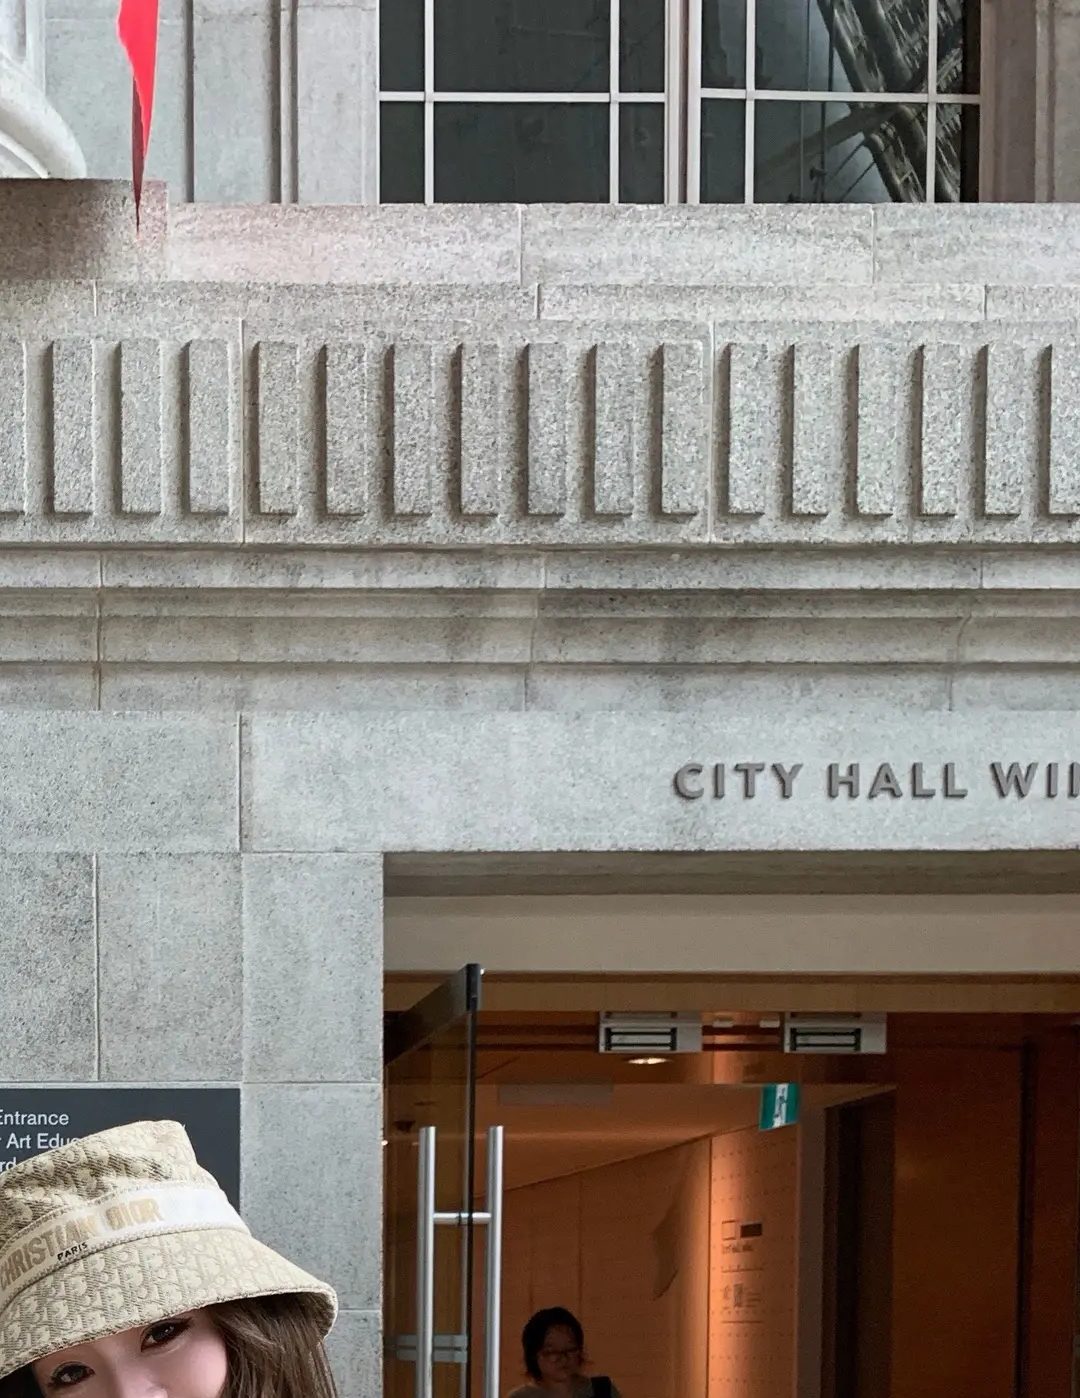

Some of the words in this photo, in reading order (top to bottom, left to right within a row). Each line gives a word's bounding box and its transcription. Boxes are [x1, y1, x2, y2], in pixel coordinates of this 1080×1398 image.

[673, 762, 803, 799] CITY
[827, 762, 968, 799] HALL
[6, 1132, 32, 1149] Art
[36, 1132, 80, 1149] Edu
[0, 1213, 102, 1291] CHRISTIAN
[105, 1197, 166, 1231] DIOR
[56, 1241, 88, 1261] PARIS
